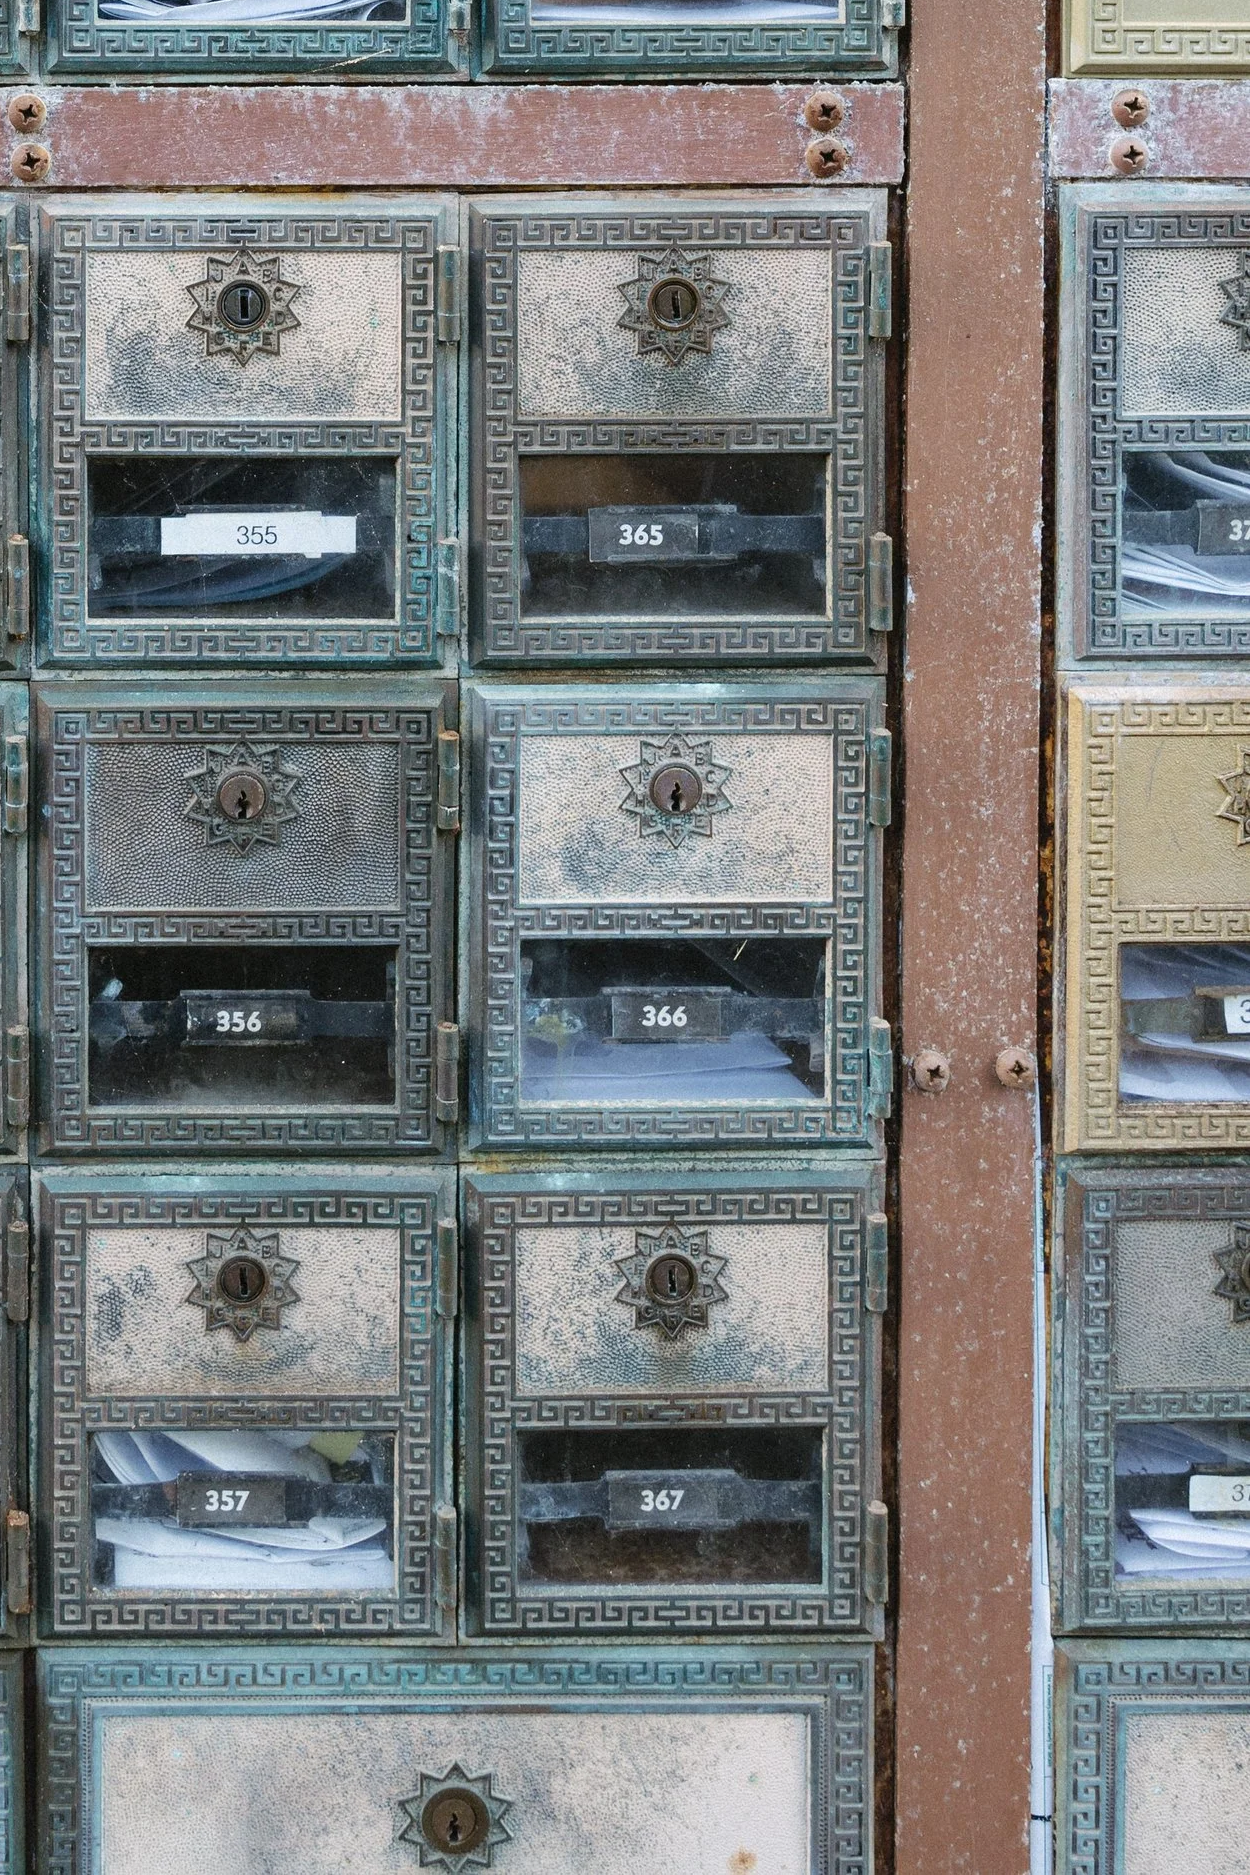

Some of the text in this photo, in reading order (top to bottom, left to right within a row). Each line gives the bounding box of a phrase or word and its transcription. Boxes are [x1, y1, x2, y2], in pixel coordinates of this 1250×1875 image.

[237, 526, 277, 544] 355
[619, 524, 663, 545] 365
[217, 1011, 261, 1032] 356
[642, 1006, 687, 1027] 366
[205, 1490, 249, 1511] 357
[641, 1490, 684, 1511] 367
